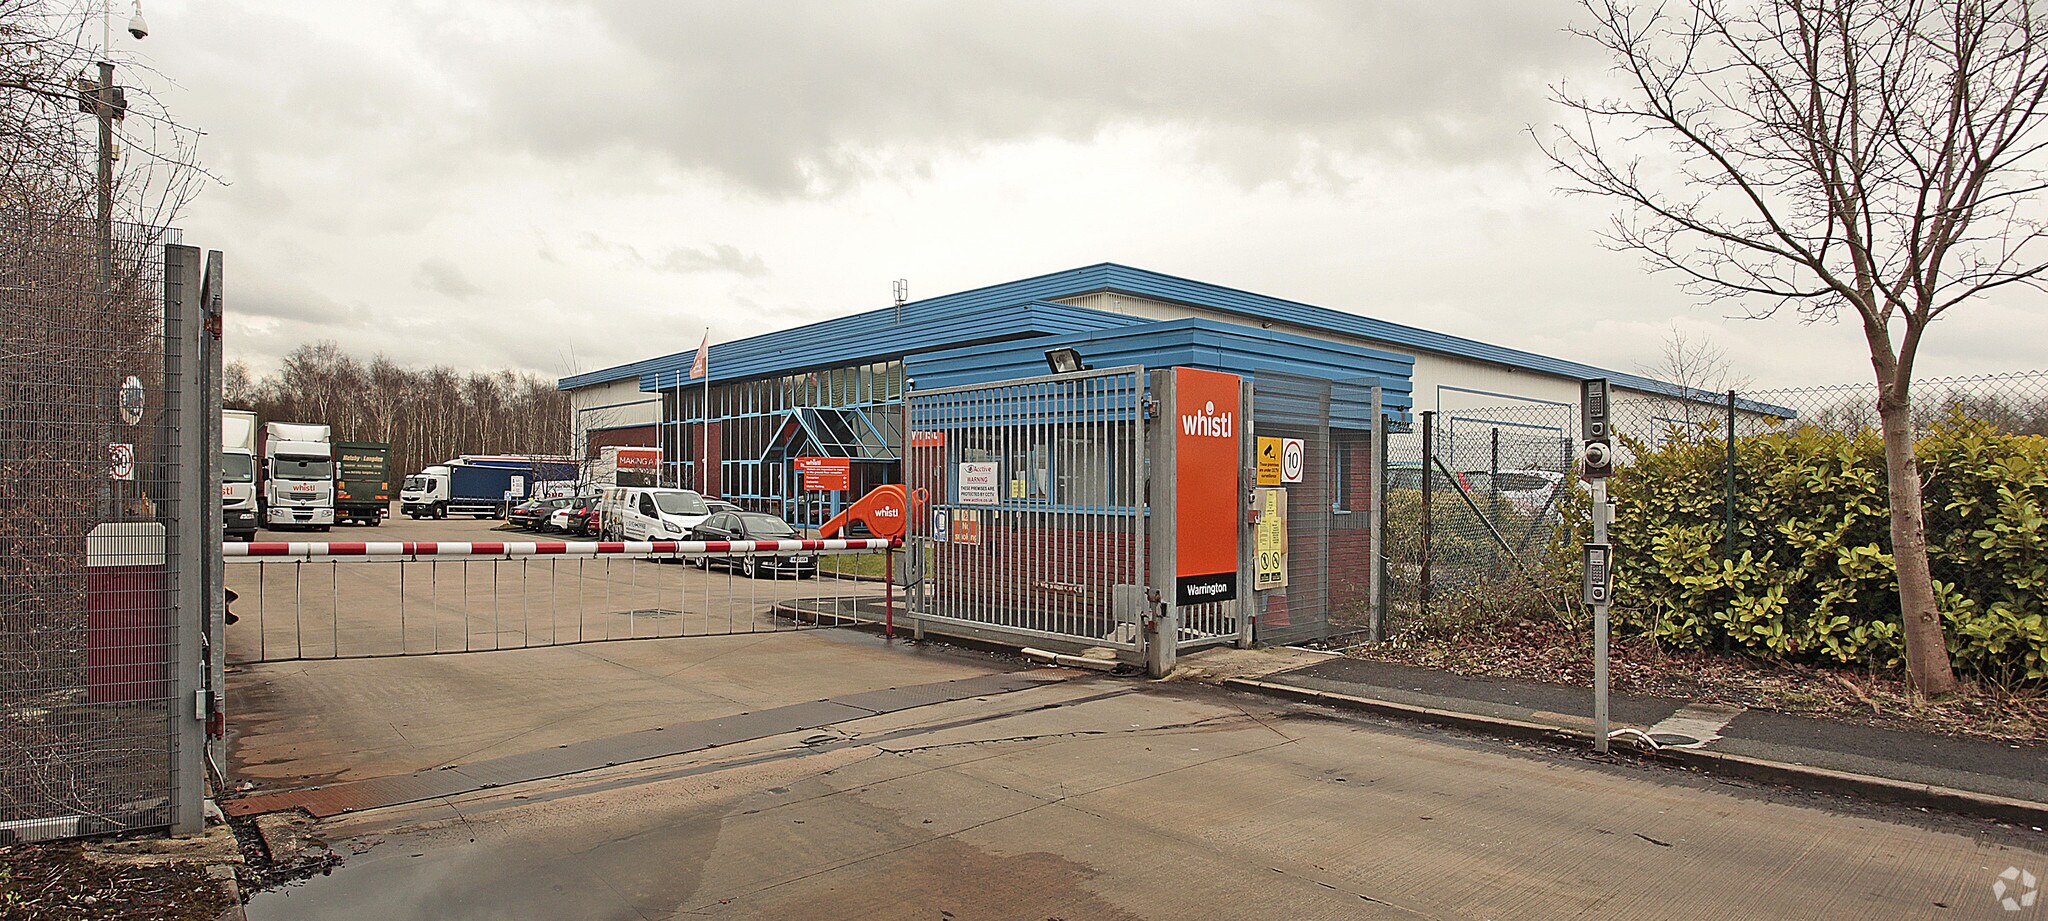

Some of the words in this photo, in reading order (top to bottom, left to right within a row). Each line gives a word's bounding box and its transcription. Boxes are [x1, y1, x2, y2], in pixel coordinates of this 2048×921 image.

[1182, 400, 1232, 438] whistl
[1287, 452, 1298, 469] 10
[222, 486, 233, 495] stl
[292, 483, 316, 491] whistl
[874, 506, 899, 517] whistl
[954, 533, 977, 542] sokng
[1187, 582, 1228, 596] Warrington
